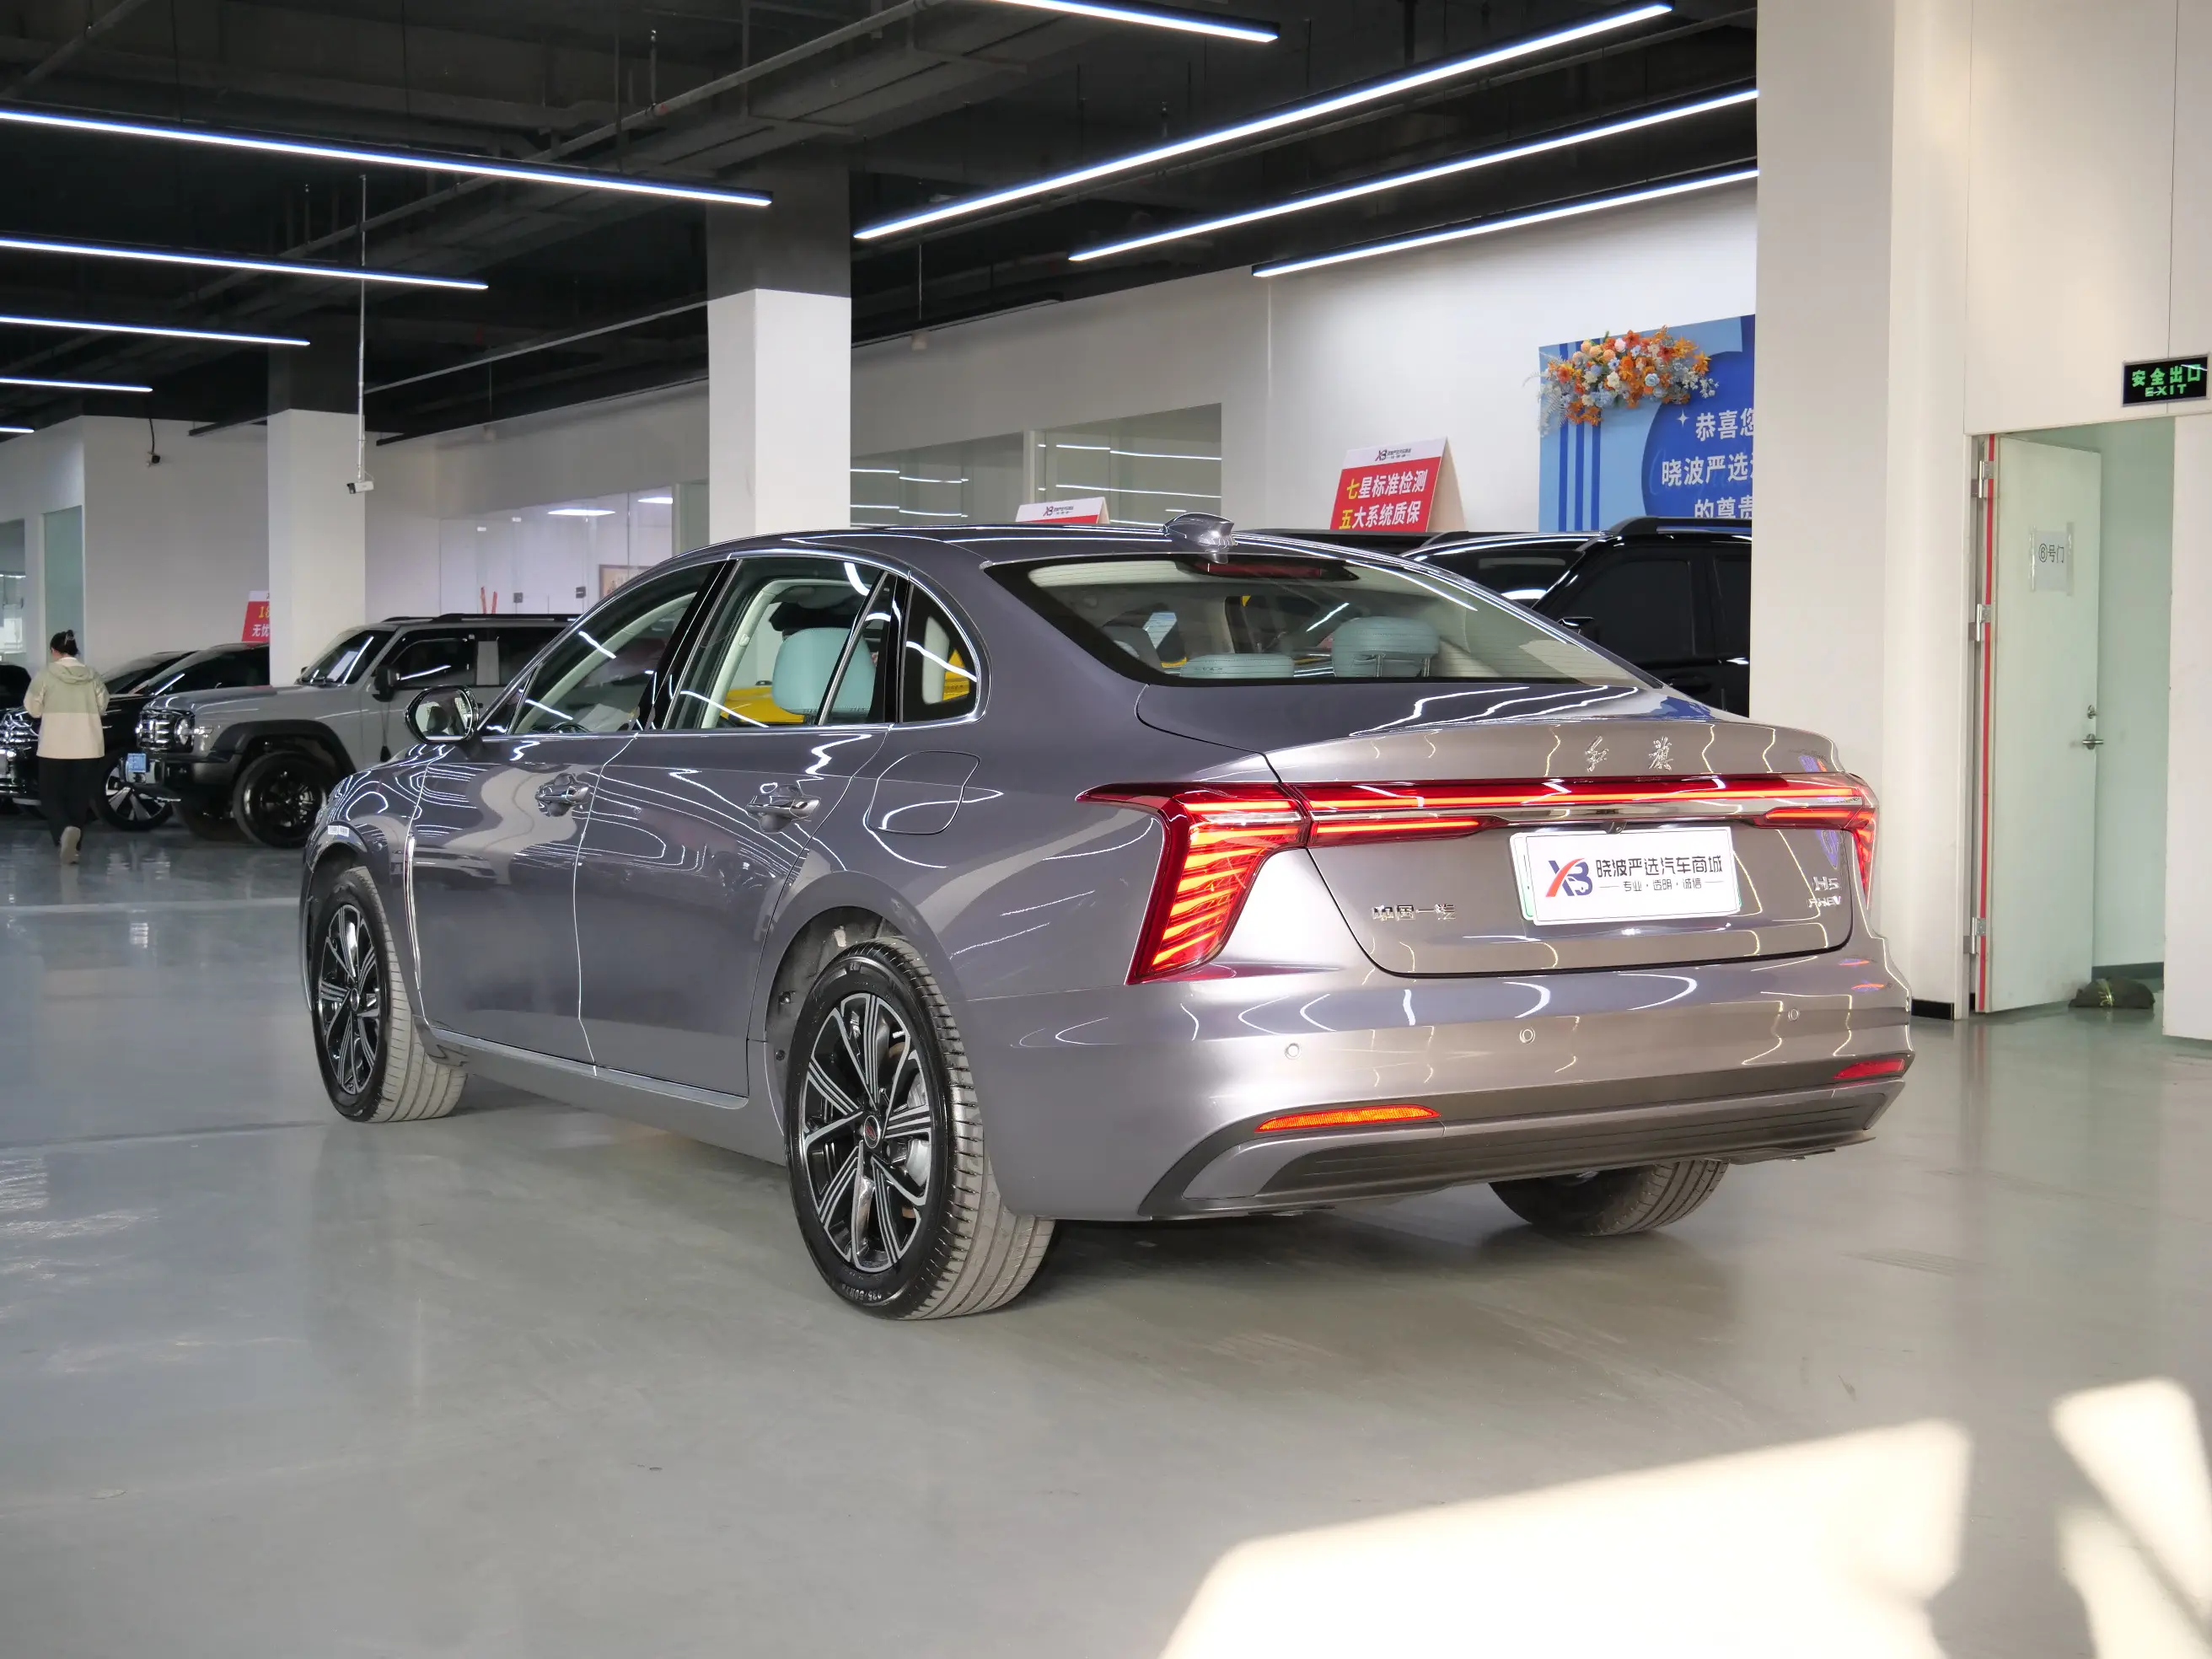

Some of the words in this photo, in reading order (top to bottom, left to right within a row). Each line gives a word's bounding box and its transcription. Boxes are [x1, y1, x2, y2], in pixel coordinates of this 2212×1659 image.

[2132, 364, 2201, 387] 安全出口
[2145, 384, 2187, 397] EXIT
[1695, 408, 1754, 442] 恭喜您
[1662, 452, 1753, 487] 晓波严选
[1347, 469, 1428, 500] 七星标准检测
[1339, 500, 1421, 529] 五大系统质保
[1596, 855, 1723, 878] 晓波严选汽车商城
[1812, 876, 1839, 891] H5
[1807, 895, 1841, 908] PHEV
